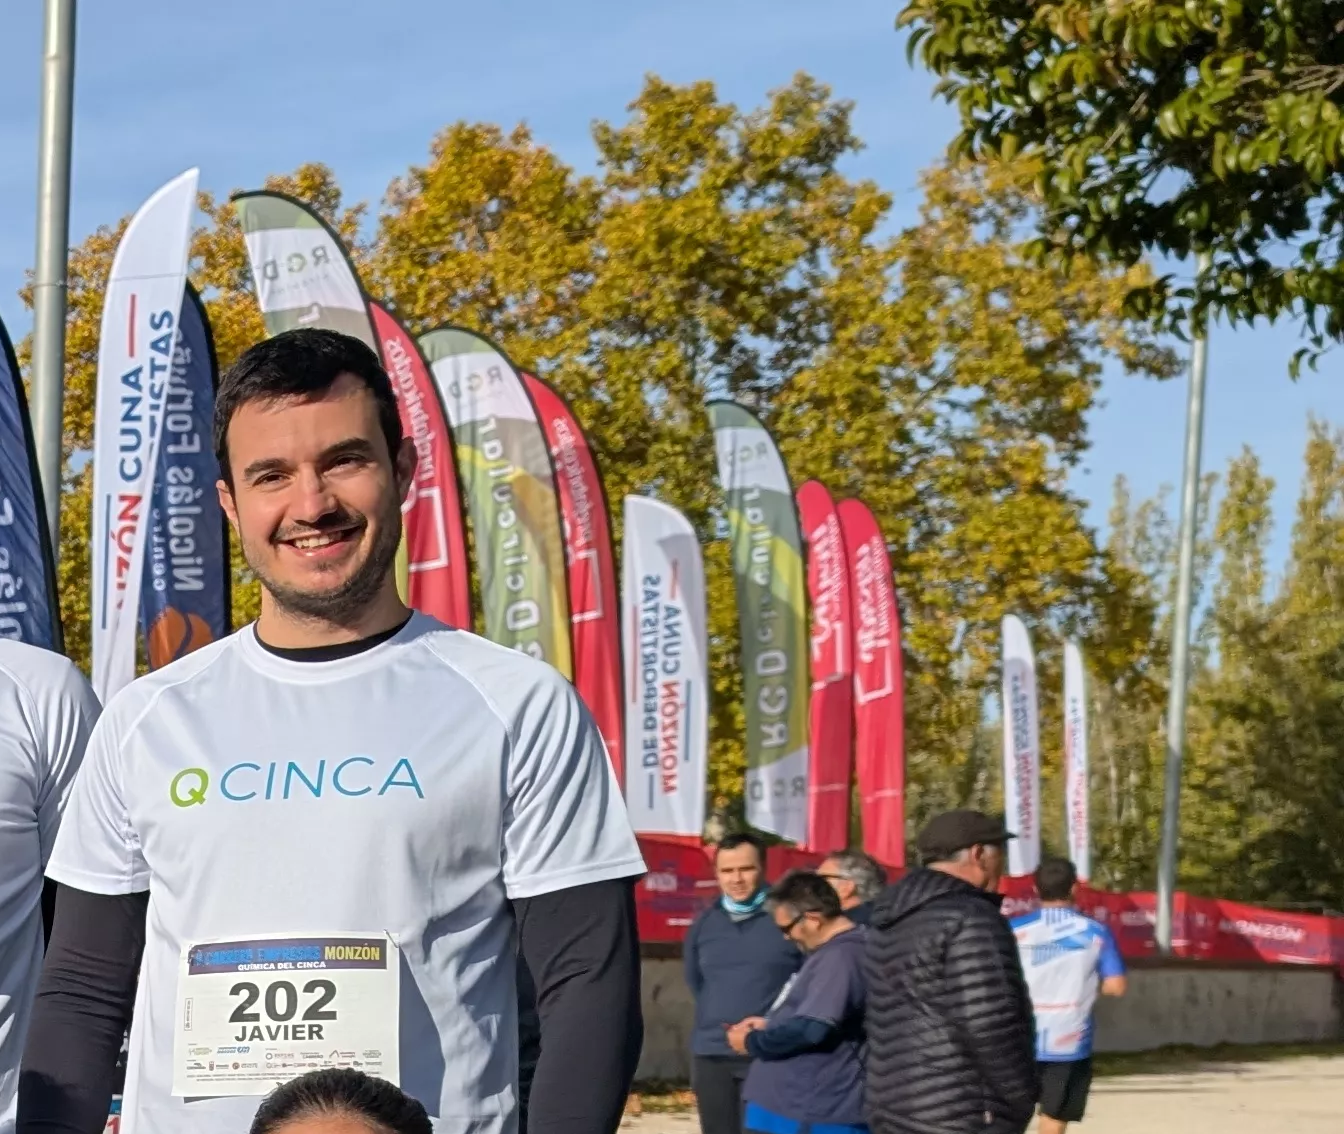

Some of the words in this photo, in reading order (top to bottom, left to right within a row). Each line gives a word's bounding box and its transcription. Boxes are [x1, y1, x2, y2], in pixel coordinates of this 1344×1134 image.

[120, 364, 143, 482] CUNA
[324, 942, 380, 960] MONZÓN
[277, 962, 295, 970] DEL
[297, 961, 326, 969] CINCA
[229, 979, 338, 1023] 202
[234, 1023, 324, 1041] JAVIER
